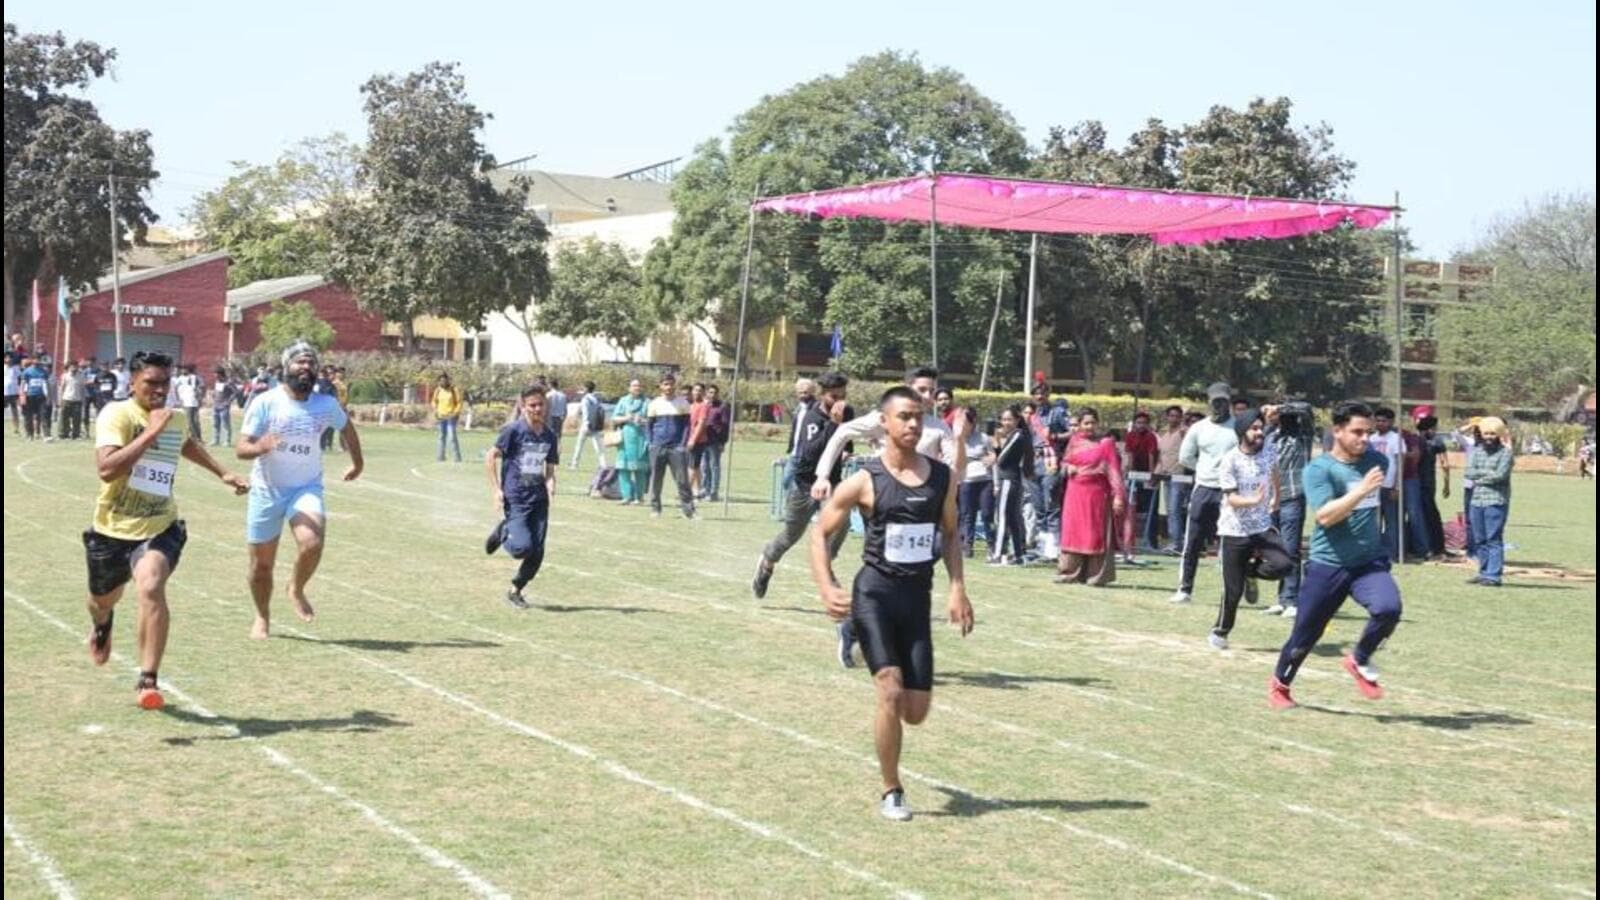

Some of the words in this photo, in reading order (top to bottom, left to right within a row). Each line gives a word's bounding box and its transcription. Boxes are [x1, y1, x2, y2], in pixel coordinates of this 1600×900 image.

[132, 317, 154, 327] LAB
[806, 422, 819, 440] P
[289, 444, 311, 456] 458
